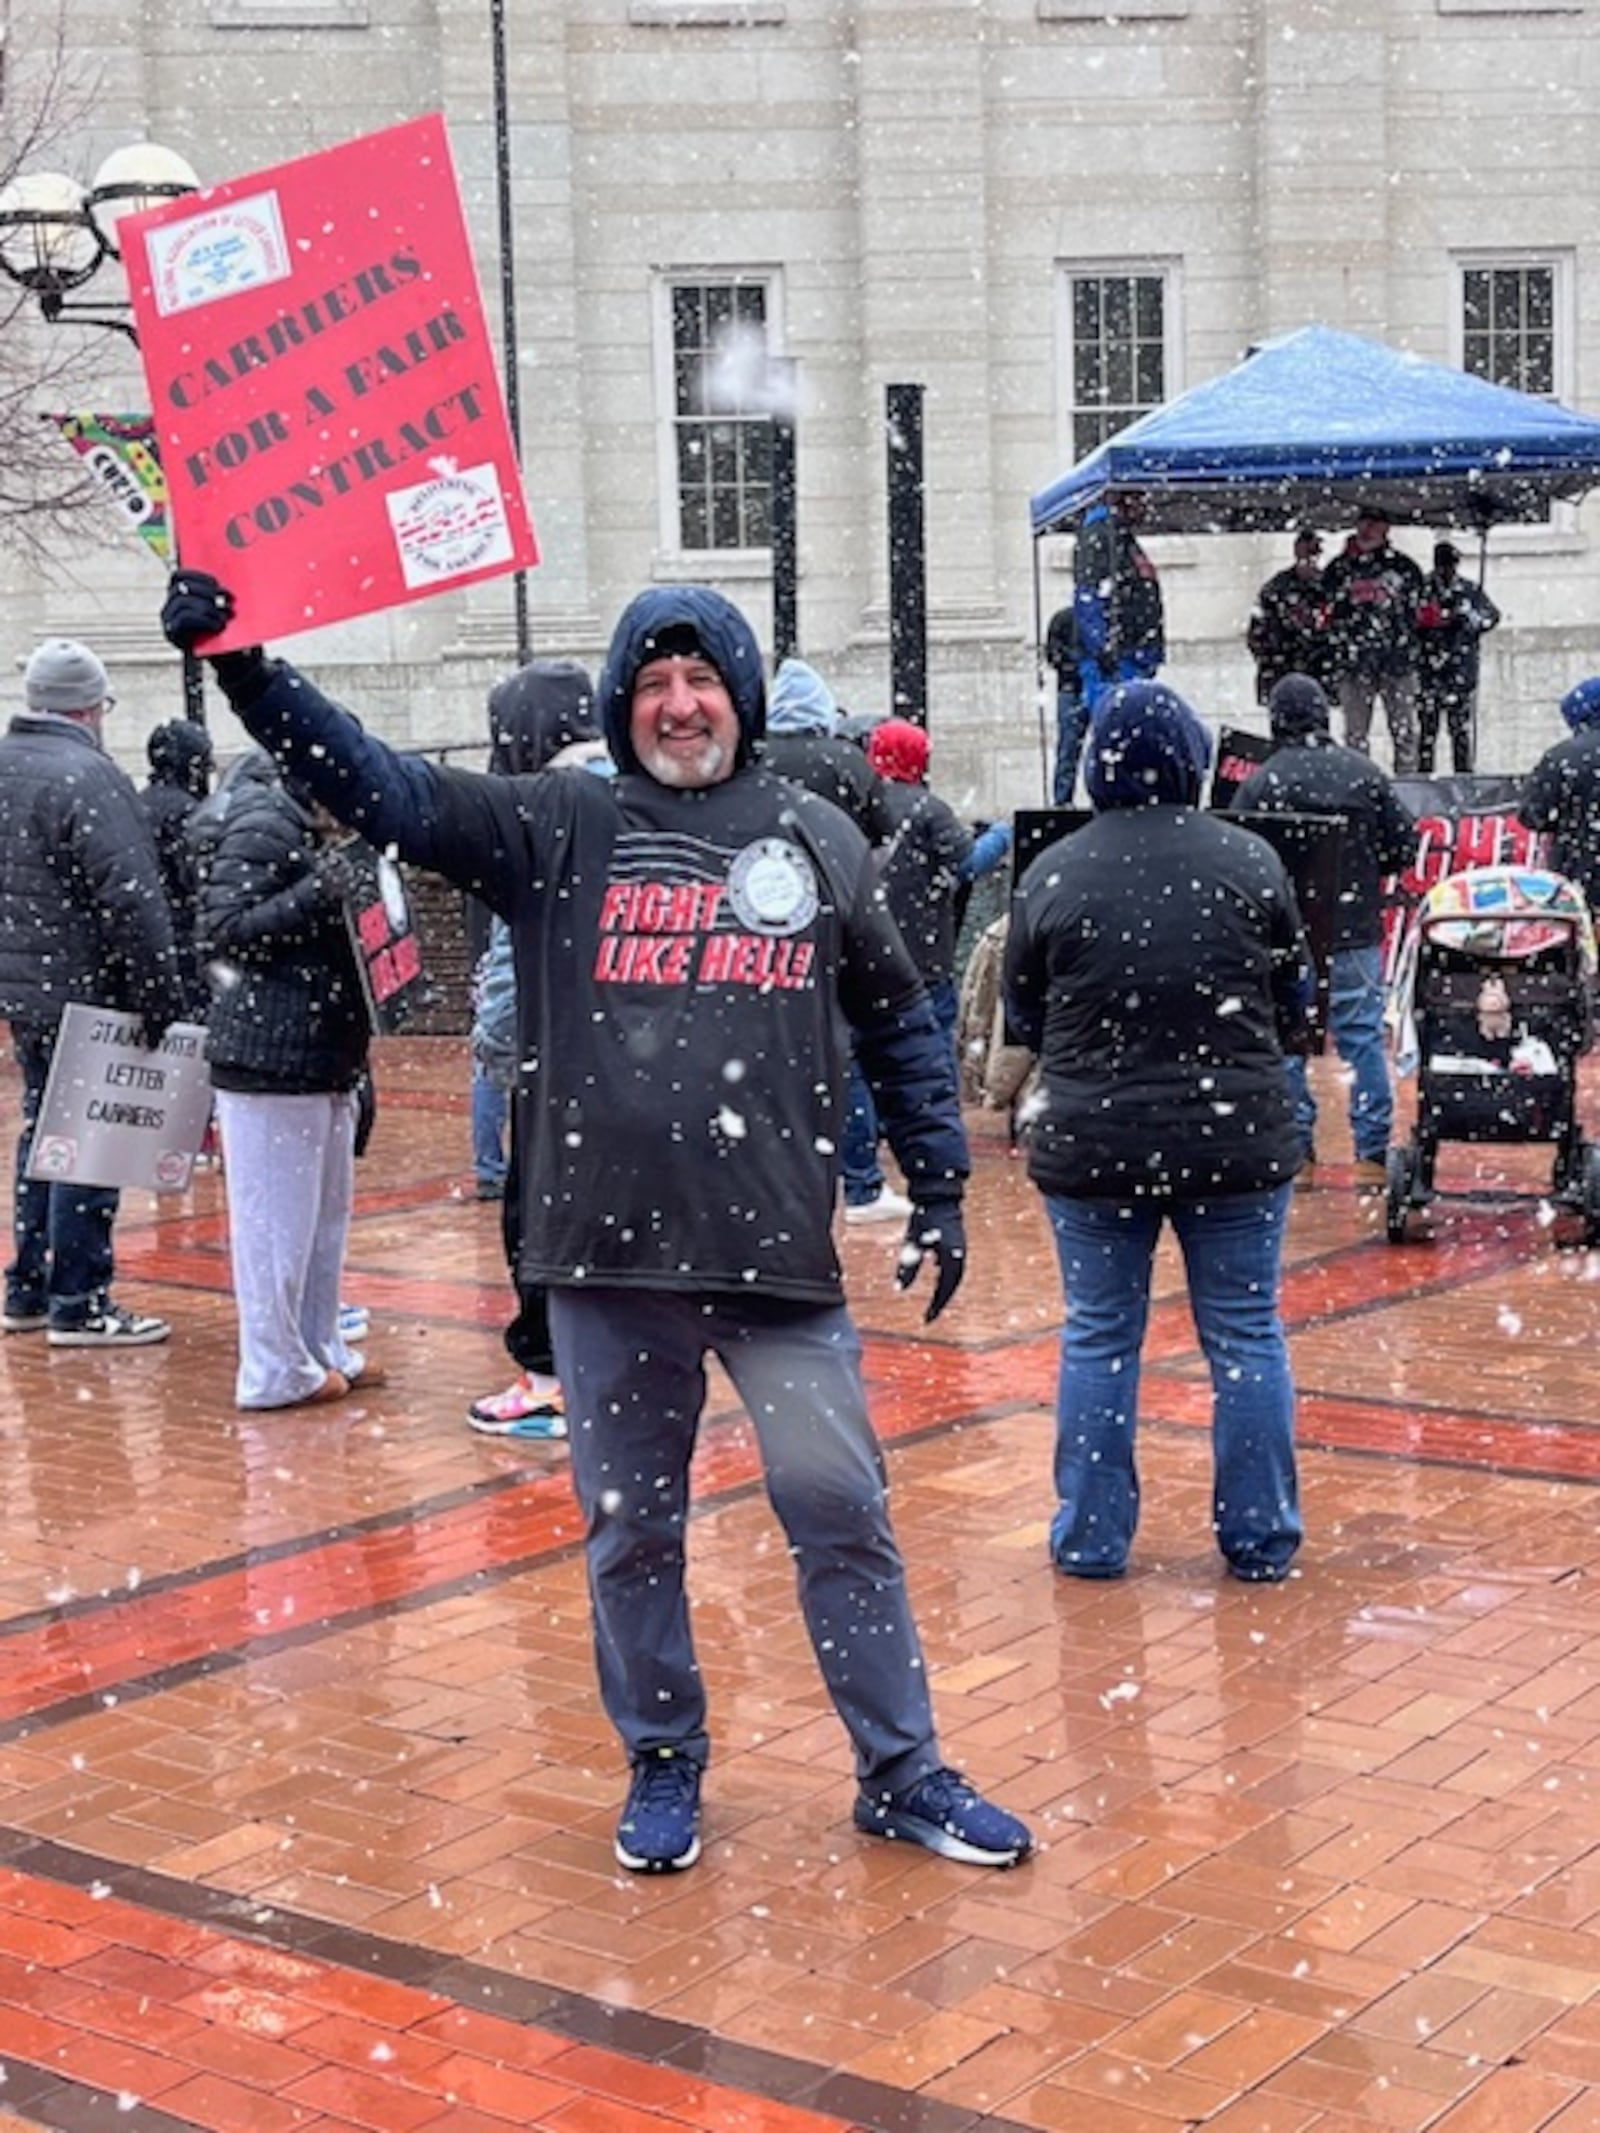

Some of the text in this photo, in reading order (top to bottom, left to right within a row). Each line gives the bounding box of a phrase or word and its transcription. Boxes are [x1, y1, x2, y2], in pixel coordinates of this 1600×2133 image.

[167, 246, 422, 410] CARRIERS
[184, 309, 468, 489] FOR A FAIR
[224, 383, 484, 551] CONTRACT
[599, 882, 727, 933] FIGHT
[593, 935, 697, 984] LIKE
[105, 1062, 167, 1091] LETTER
[86, 1098, 166, 1130] CARRIERS
